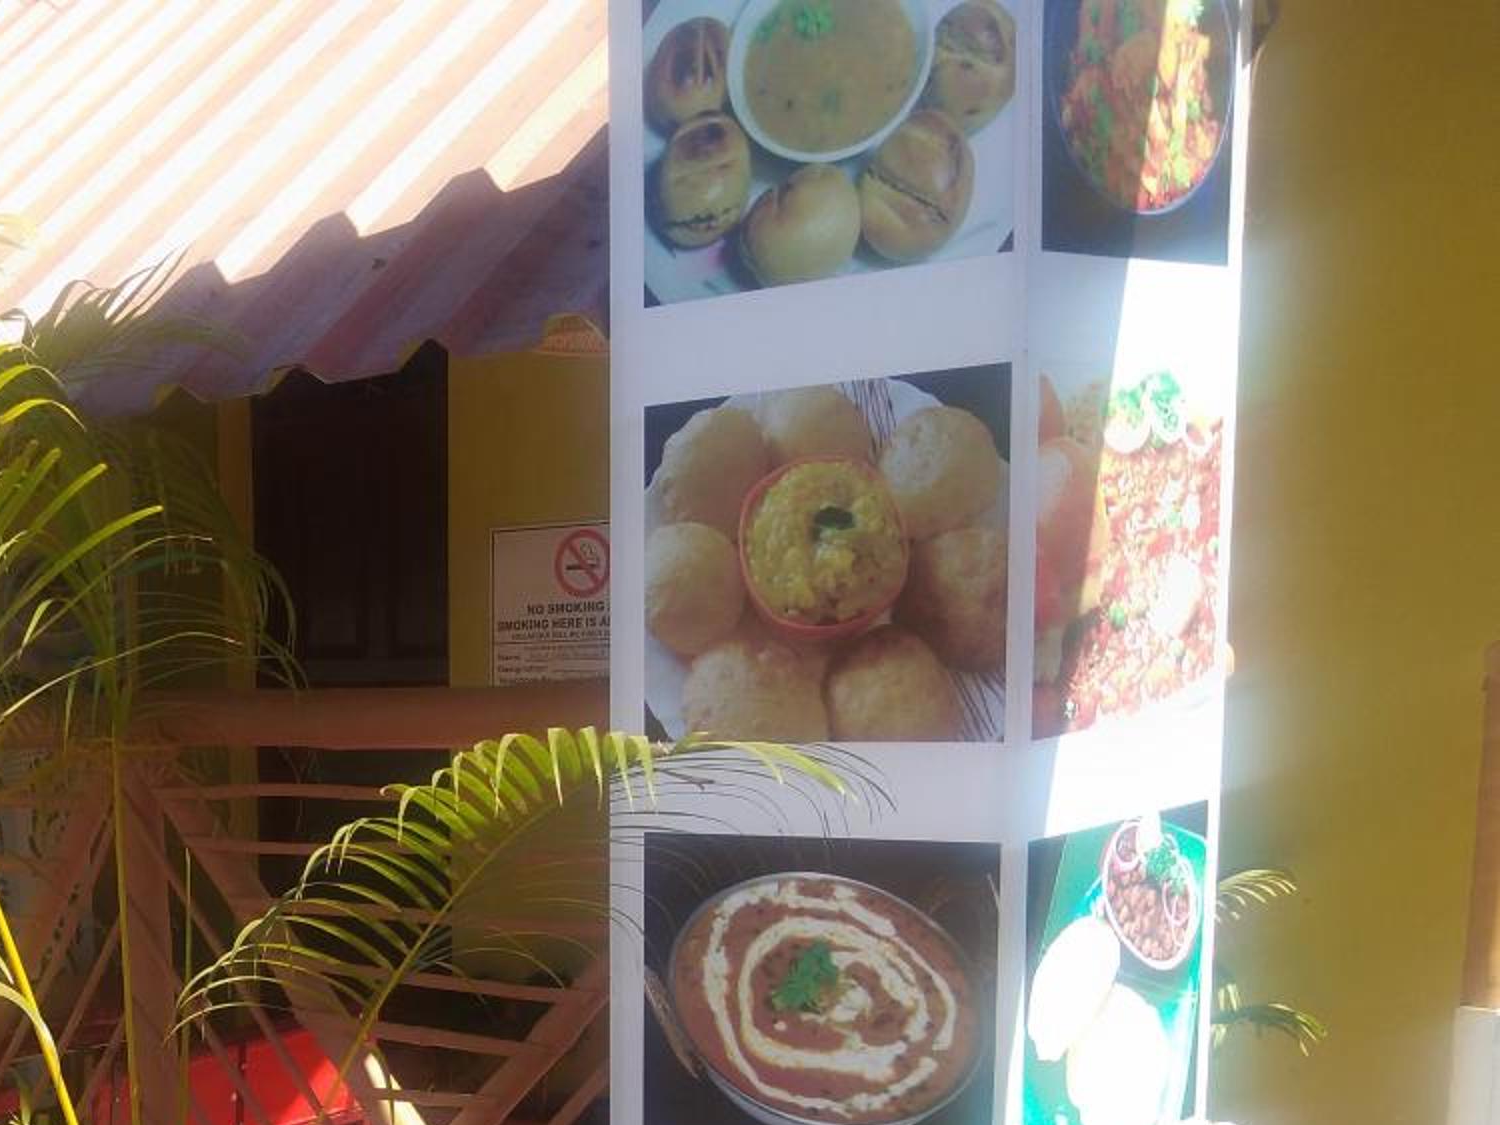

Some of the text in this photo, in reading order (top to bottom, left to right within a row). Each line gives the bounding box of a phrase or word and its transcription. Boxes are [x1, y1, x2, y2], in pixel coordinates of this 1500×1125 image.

[526, 600, 605, 615] NO SMOKING
[497, 619, 549, 632] SMOKING
[551, 617, 583, 629] HERE
